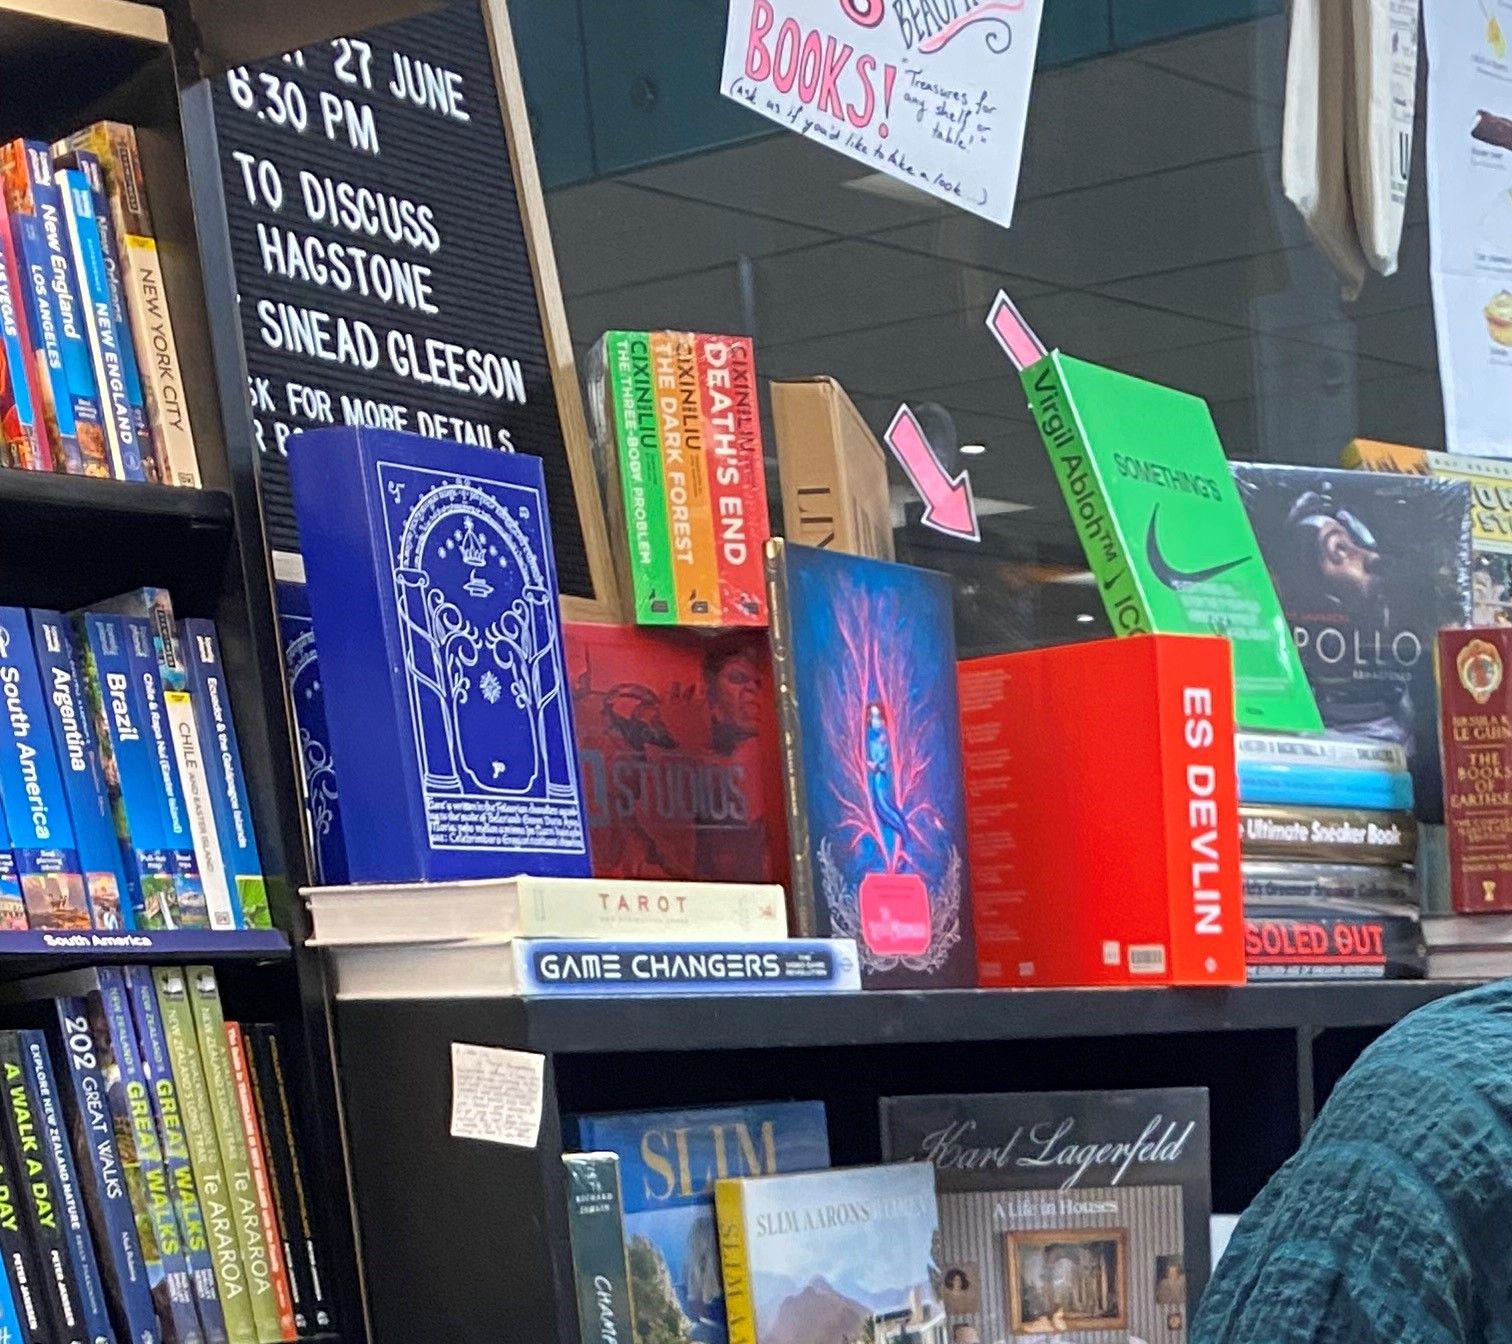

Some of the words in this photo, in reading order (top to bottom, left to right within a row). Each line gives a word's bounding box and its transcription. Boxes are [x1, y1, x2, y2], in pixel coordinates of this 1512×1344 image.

[331, 36, 373, 91] 27
[389, 50, 471, 122] JUNE
[744, 0, 897, 140] BOOKS!
[226, 64, 308, 134] 6.30
[319, 90, 381, 156] PM
[41, 203, 62, 254] New
[232, 150, 283, 213] TO
[300, 170, 441, 255] DISCUSS
[31, 264, 48, 296] LOS
[50, 254, 82, 340] England
[139, 267, 163, 320] NEW
[257, 222, 439, 315] HAGSTONE
[38, 296, 62, 369] ANGELES
[95, 302, 116, 348] NEW
[150, 321, 175, 384] YORK
[257, 299, 380, 371] SINEAD
[386, 328, 528, 406] GLEESON
[104, 351, 133, 445] ENGLAND
[654, 344, 677, 390] THE
[161, 384, 184, 433] CITY
[284, 382, 335, 424] FOR
[339, 394, 409, 434] MORE
[660, 395, 685, 465] DARK
[703, 342, 740, 486] DEATH'S
[1033, 367, 1075, 449] Virgil
[615, 339, 632, 371] THE
[631, 487, 651, 565] PROBLEM
[667, 471, 694, 565] FOREST
[719, 495, 747, 566] END
[1292, 626, 1422, 668] POLLO
[52, 666, 86, 772] Argentina
[106, 672, 139, 742] Brazil
[1182, 686, 1214, 749] ES
[1, 665, 31, 737] South
[17, 742, 51, 840] America
[179, 721, 198, 769] CHILE
[1457, 766, 1512, 781] BOOKS
[1468, 752, 1500, 767] THE
[1474, 779, 1495, 793] OF
[1186, 764, 1223, 935] DEVLIN
[1246, 817, 1309, 843] Ultimate
[1311, 820, 1367, 845] Sneaker
[1367, 822, 1402, 846] Book
[599, 892, 688, 914] TAROT
[43, 933, 91, 948] South
[92, 934, 152, 948] America
[539, 953, 622, 980] GAME
[631, 953, 781, 979] CHANGERS
[1244, 922, 1329, 956] SOLED
[1332, 922, 1385, 955] OUT
[4, 1062, 21, 1080] A
[29, 1043, 50, 1097] EXPLORE
[9, 1085, 38, 1152] WALK
[43, 1097, 58, 1128] NEW
[64, 1016, 97, 1072] 202
[81, 1076, 109, 1134] GREAT
[97, 1139, 123, 1200] WALKS
[25, 1158, 43, 1177] A
[49, 1128, 70, 1185] ZEALAND
[233, 1170, 249, 1192] Te
[640, 1119, 777, 1201] SLIM
[920, 1119, 1024, 1170] Karl
[1015, 1113, 1196, 1190] Lagerfeld
[32, 1182, 57, 1229] DAY
[61, 1183, 81, 1231] NATURE
[146, 1167, 180, 1256] WALKS
[173, 1165, 206, 1252] WALKS
[203, 1172, 222, 1196] Te
[207, 1200, 244, 1300] ARAROA
[238, 1197, 272, 1297] ARAROA
[755, 1211, 800, 1238] SLIM
[802, 1201, 871, 1231] AARONS
